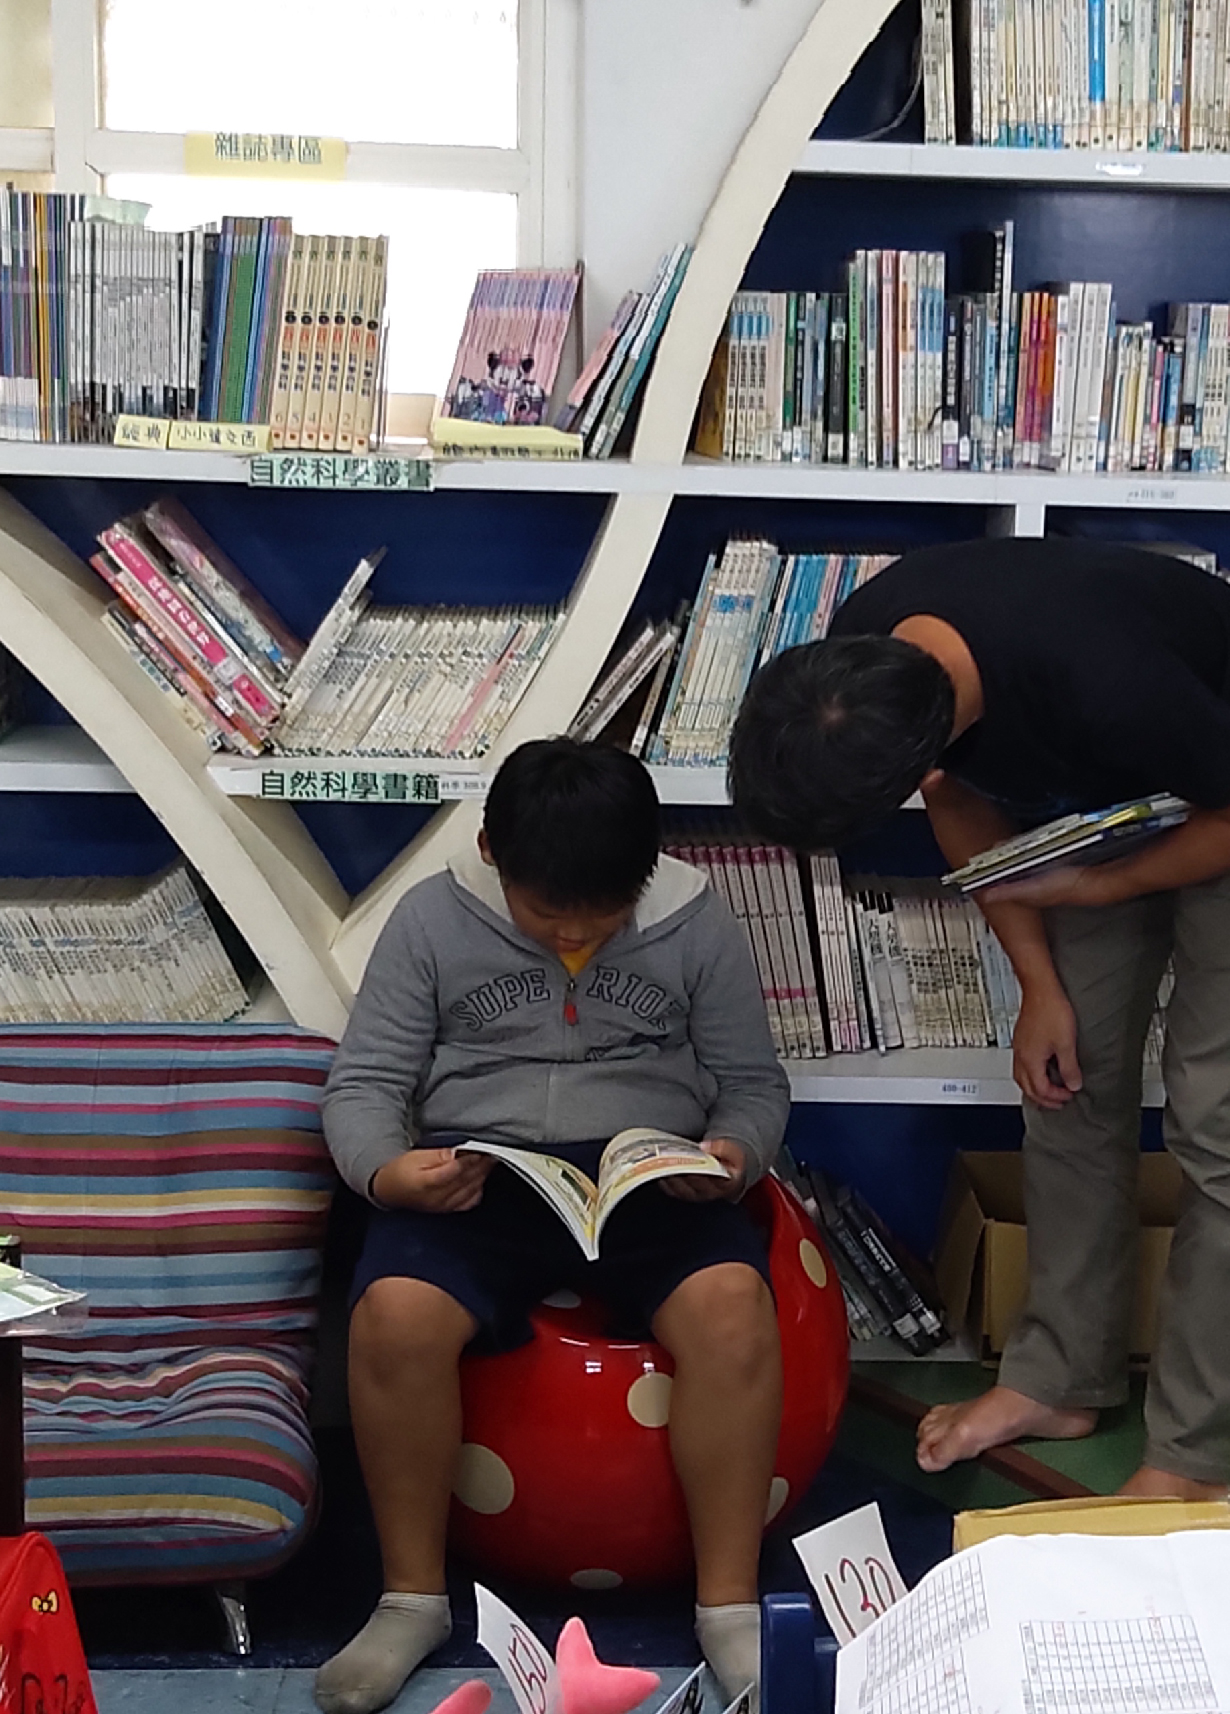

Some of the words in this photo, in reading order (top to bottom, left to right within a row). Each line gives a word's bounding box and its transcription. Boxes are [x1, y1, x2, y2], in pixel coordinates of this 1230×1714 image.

[214, 131, 322, 165] 雜誌專區
[250, 455, 432, 487] 自然科學叢書
[261, 769, 440, 800] 自然科學書籍
[450, 967, 550, 1032] SUPE
